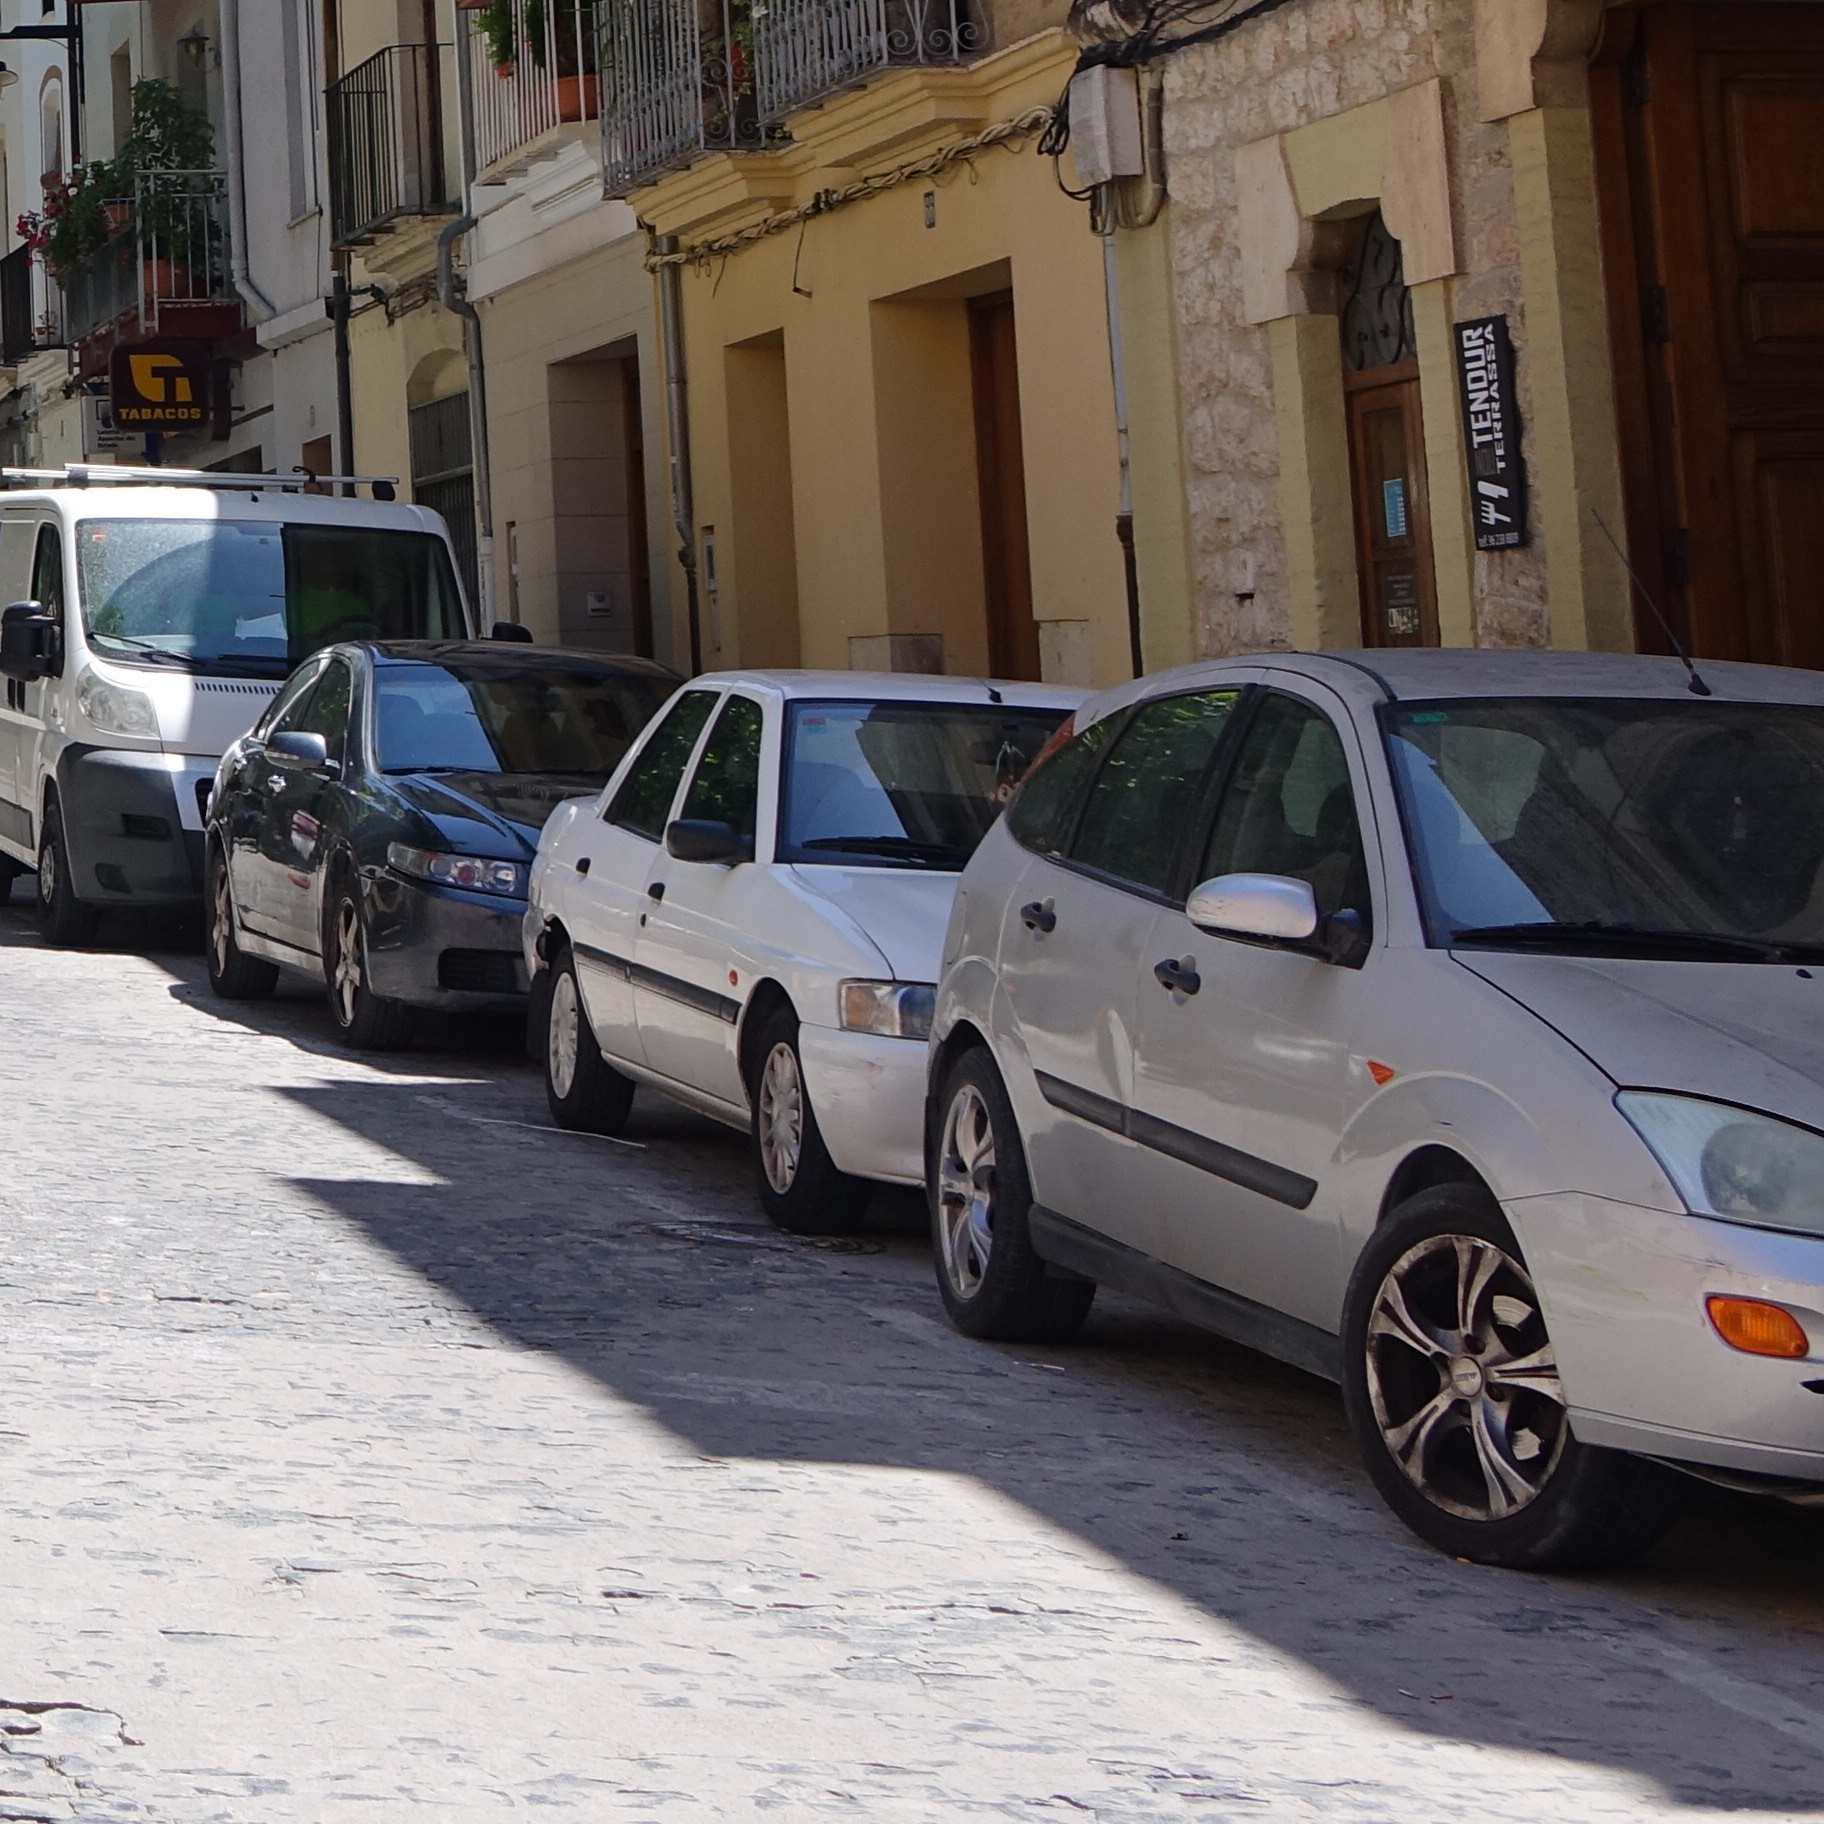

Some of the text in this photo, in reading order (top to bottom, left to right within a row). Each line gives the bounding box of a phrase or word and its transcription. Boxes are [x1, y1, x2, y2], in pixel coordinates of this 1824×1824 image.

[118, 408, 201, 420] TABACOS
[1462, 326, 1494, 449] TENDUR
[1484, 323, 1506, 473] TERRASSA
